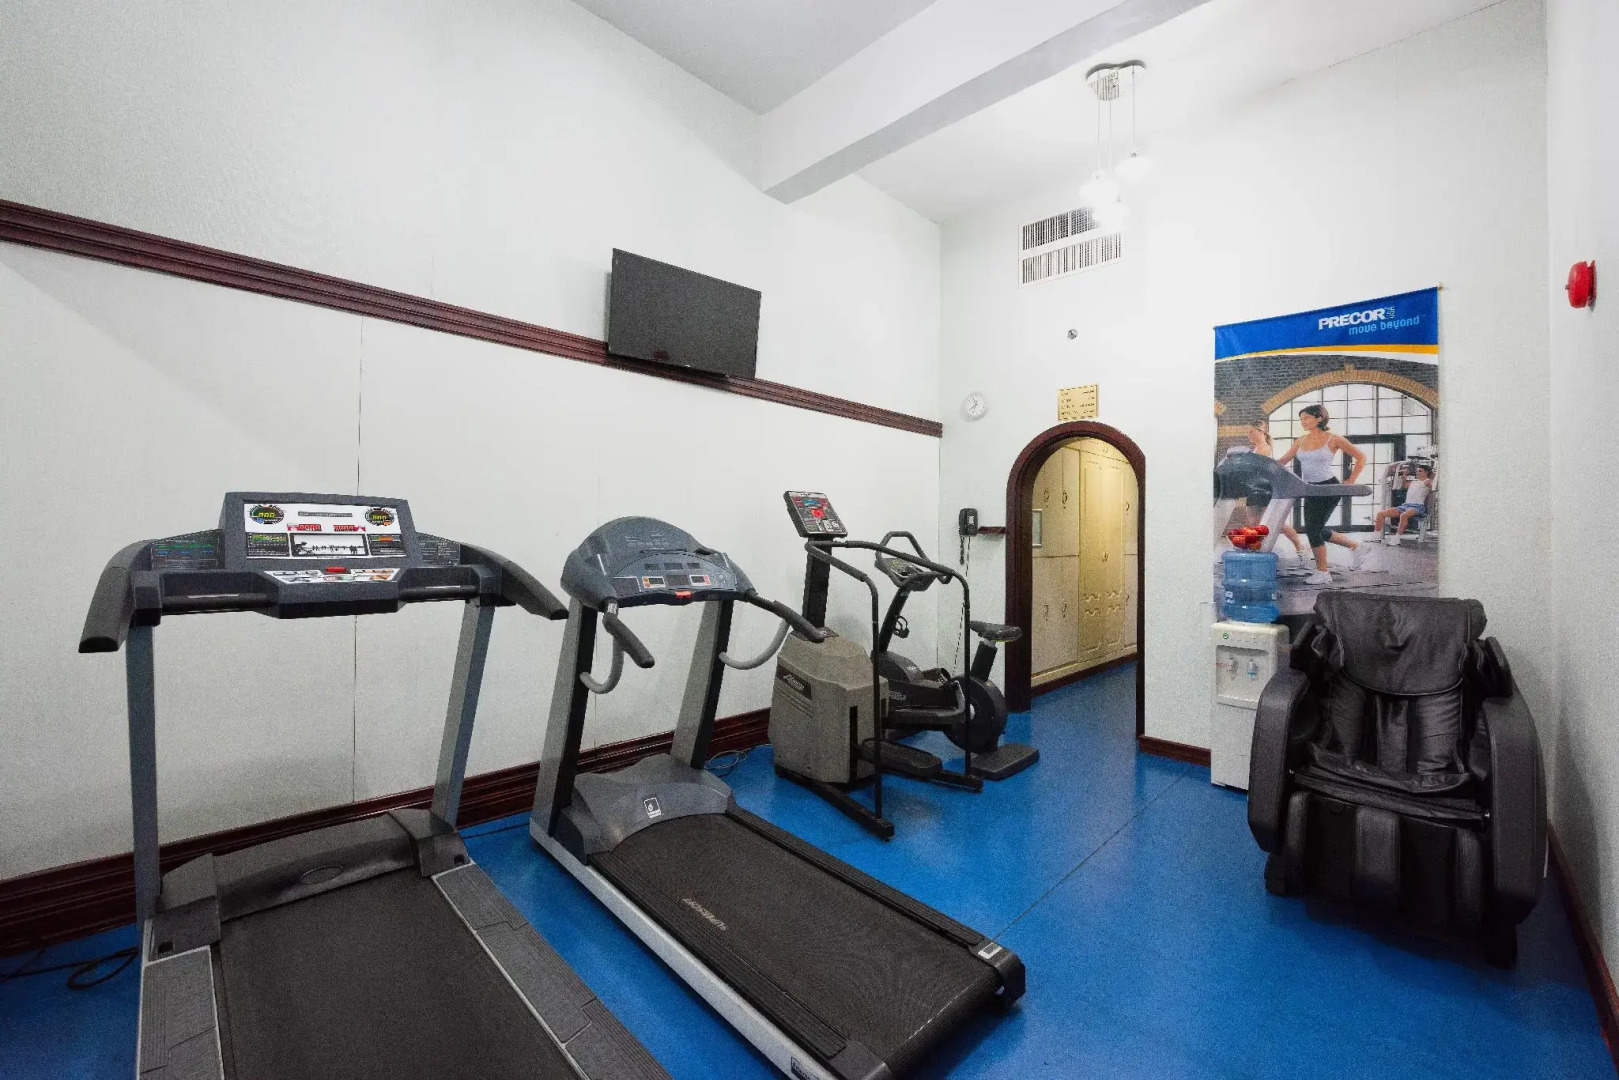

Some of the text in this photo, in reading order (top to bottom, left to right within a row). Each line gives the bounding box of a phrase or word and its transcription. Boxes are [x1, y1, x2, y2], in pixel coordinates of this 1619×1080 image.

[1318, 307, 1386, 330] PRECOR
[1348, 315, 1420, 336] move beyond
